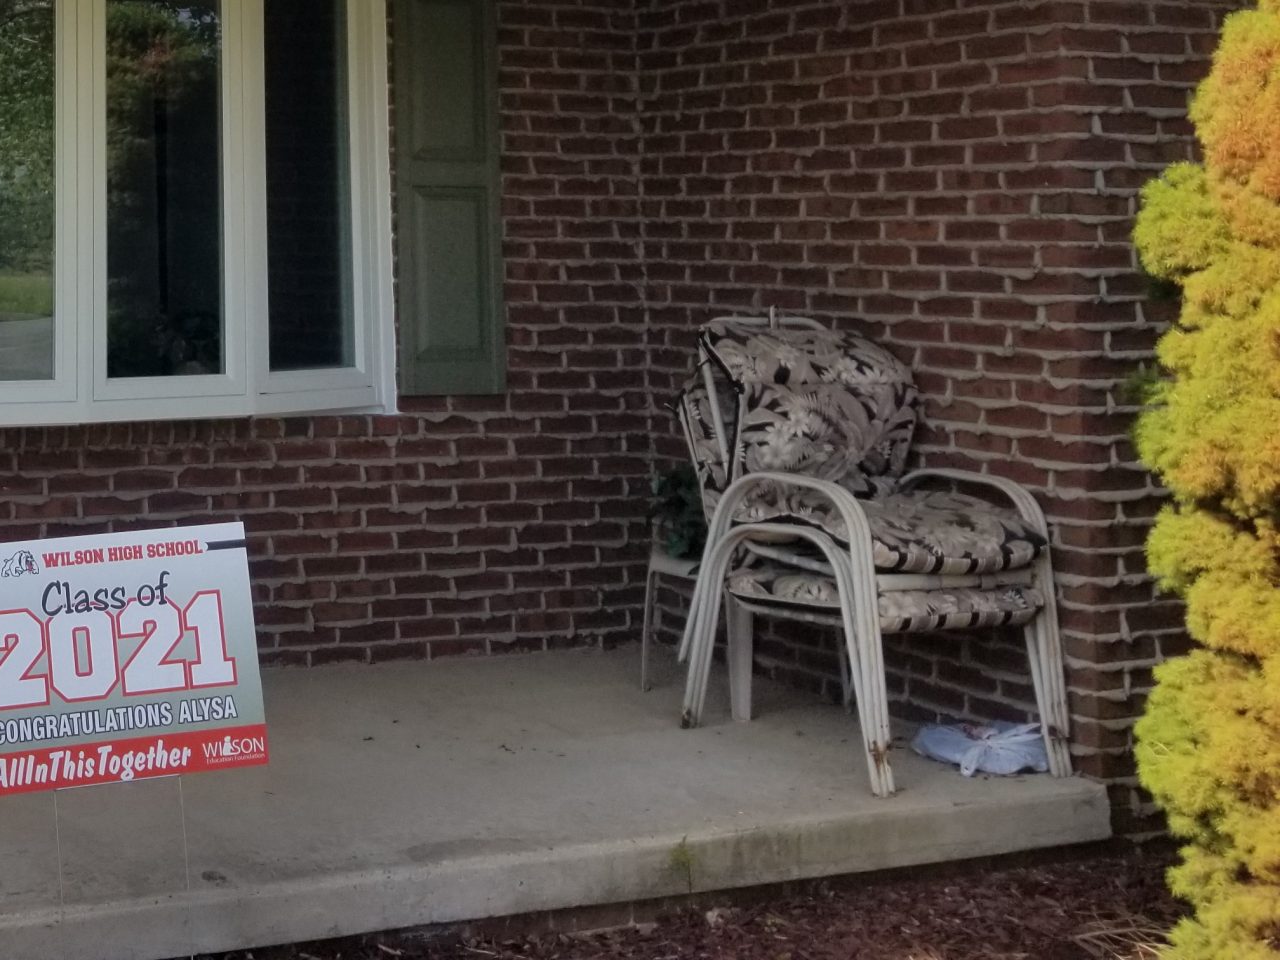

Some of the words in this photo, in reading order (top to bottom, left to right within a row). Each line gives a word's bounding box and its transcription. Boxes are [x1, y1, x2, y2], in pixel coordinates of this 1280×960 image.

[42, 548, 104, 568] WILSON
[108, 545, 143, 562] HIGH
[147, 540, 203, 558] SCHOOL
[41, 580, 127, 616] Class
[137, 571, 170, 606] of
[179, 695, 238, 724] ALYSA
[207, 755, 233, 765] Education
[234, 753, 266, 761] Foundation
